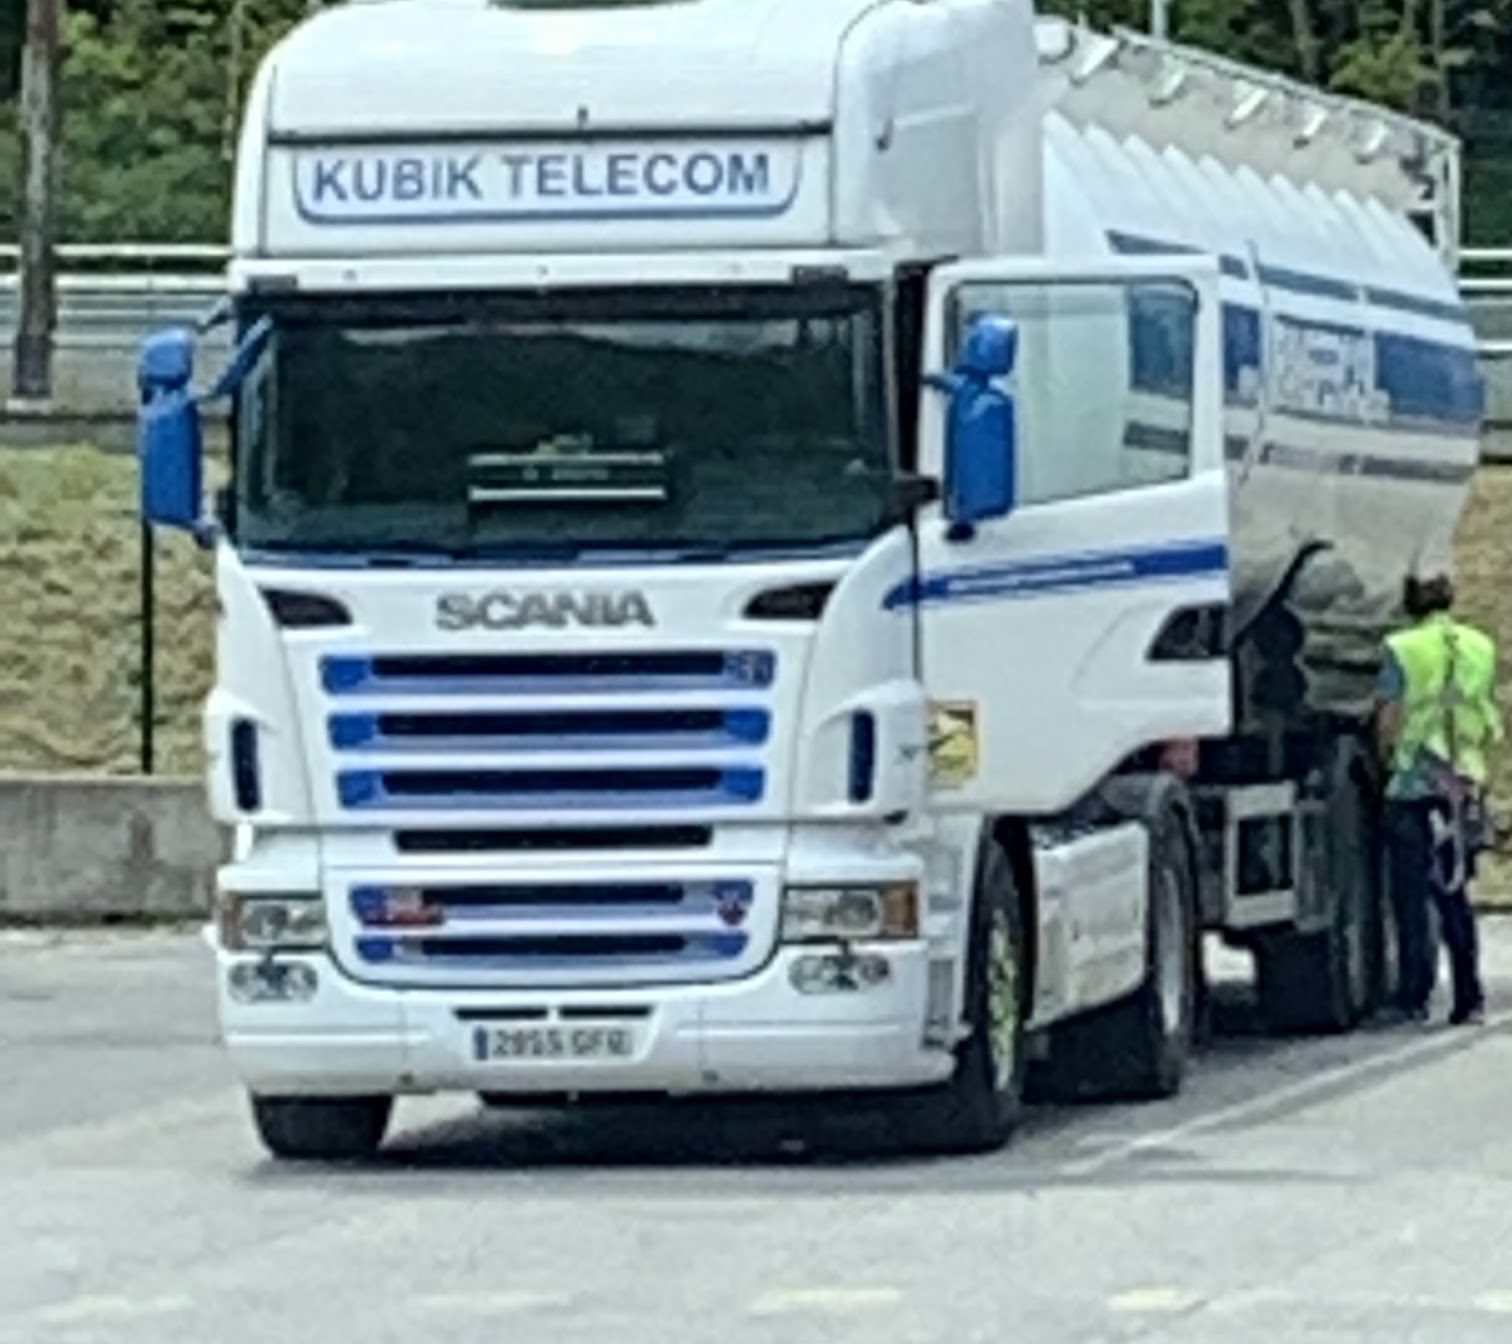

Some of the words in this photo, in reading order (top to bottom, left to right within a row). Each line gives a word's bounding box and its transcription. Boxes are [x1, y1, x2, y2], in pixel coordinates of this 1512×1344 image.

[313, 157, 482, 202] KUBIK
[502, 152, 769, 199] TELECOM
[434, 589, 657, 631] SCANIA
